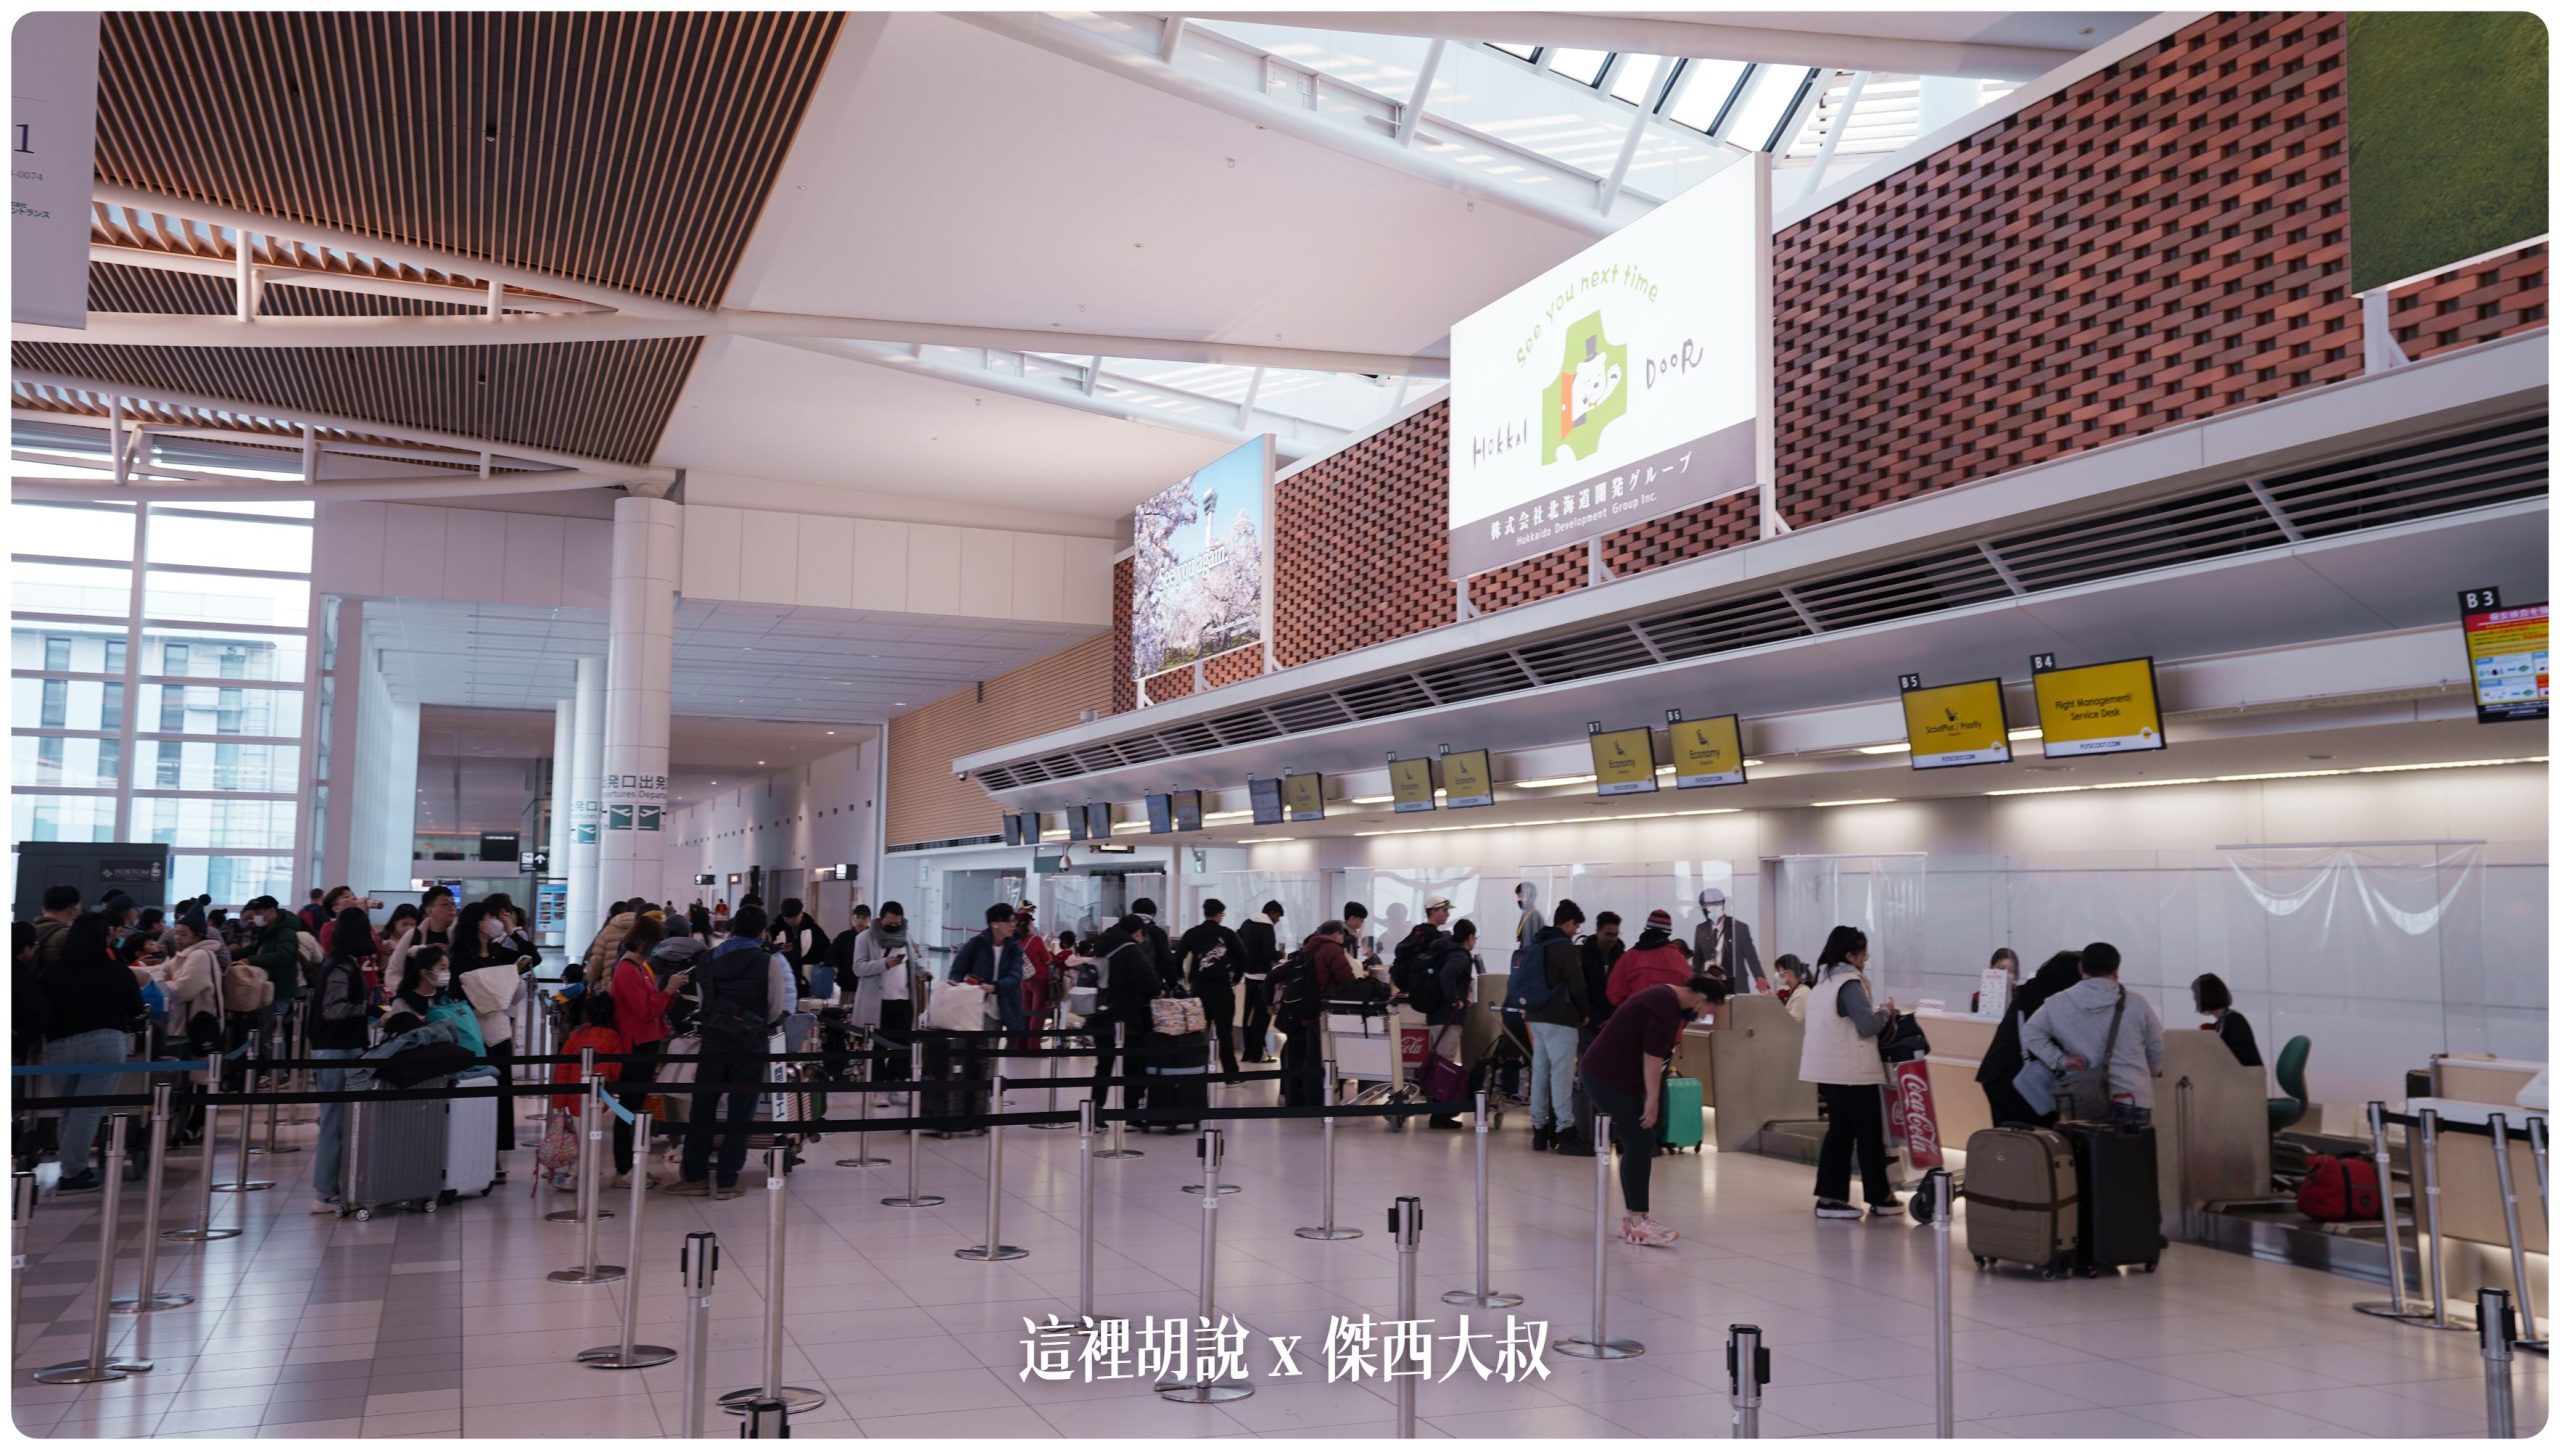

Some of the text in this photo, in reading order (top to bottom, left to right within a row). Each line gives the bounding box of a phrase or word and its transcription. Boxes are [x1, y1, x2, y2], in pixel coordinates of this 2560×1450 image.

[13, 123, 35, 154] 1
[1545, 284, 1574, 325] you
[1581, 263, 1618, 293] next
[1624, 264, 1658, 302] time
[1516, 492, 1657, 547] Hokkaido Development Group Inc.
[2055, 700, 2075, 711] Flight
[2070, 707, 2121, 721] Service Desk
[1689, 749, 1721, 760] Economy
